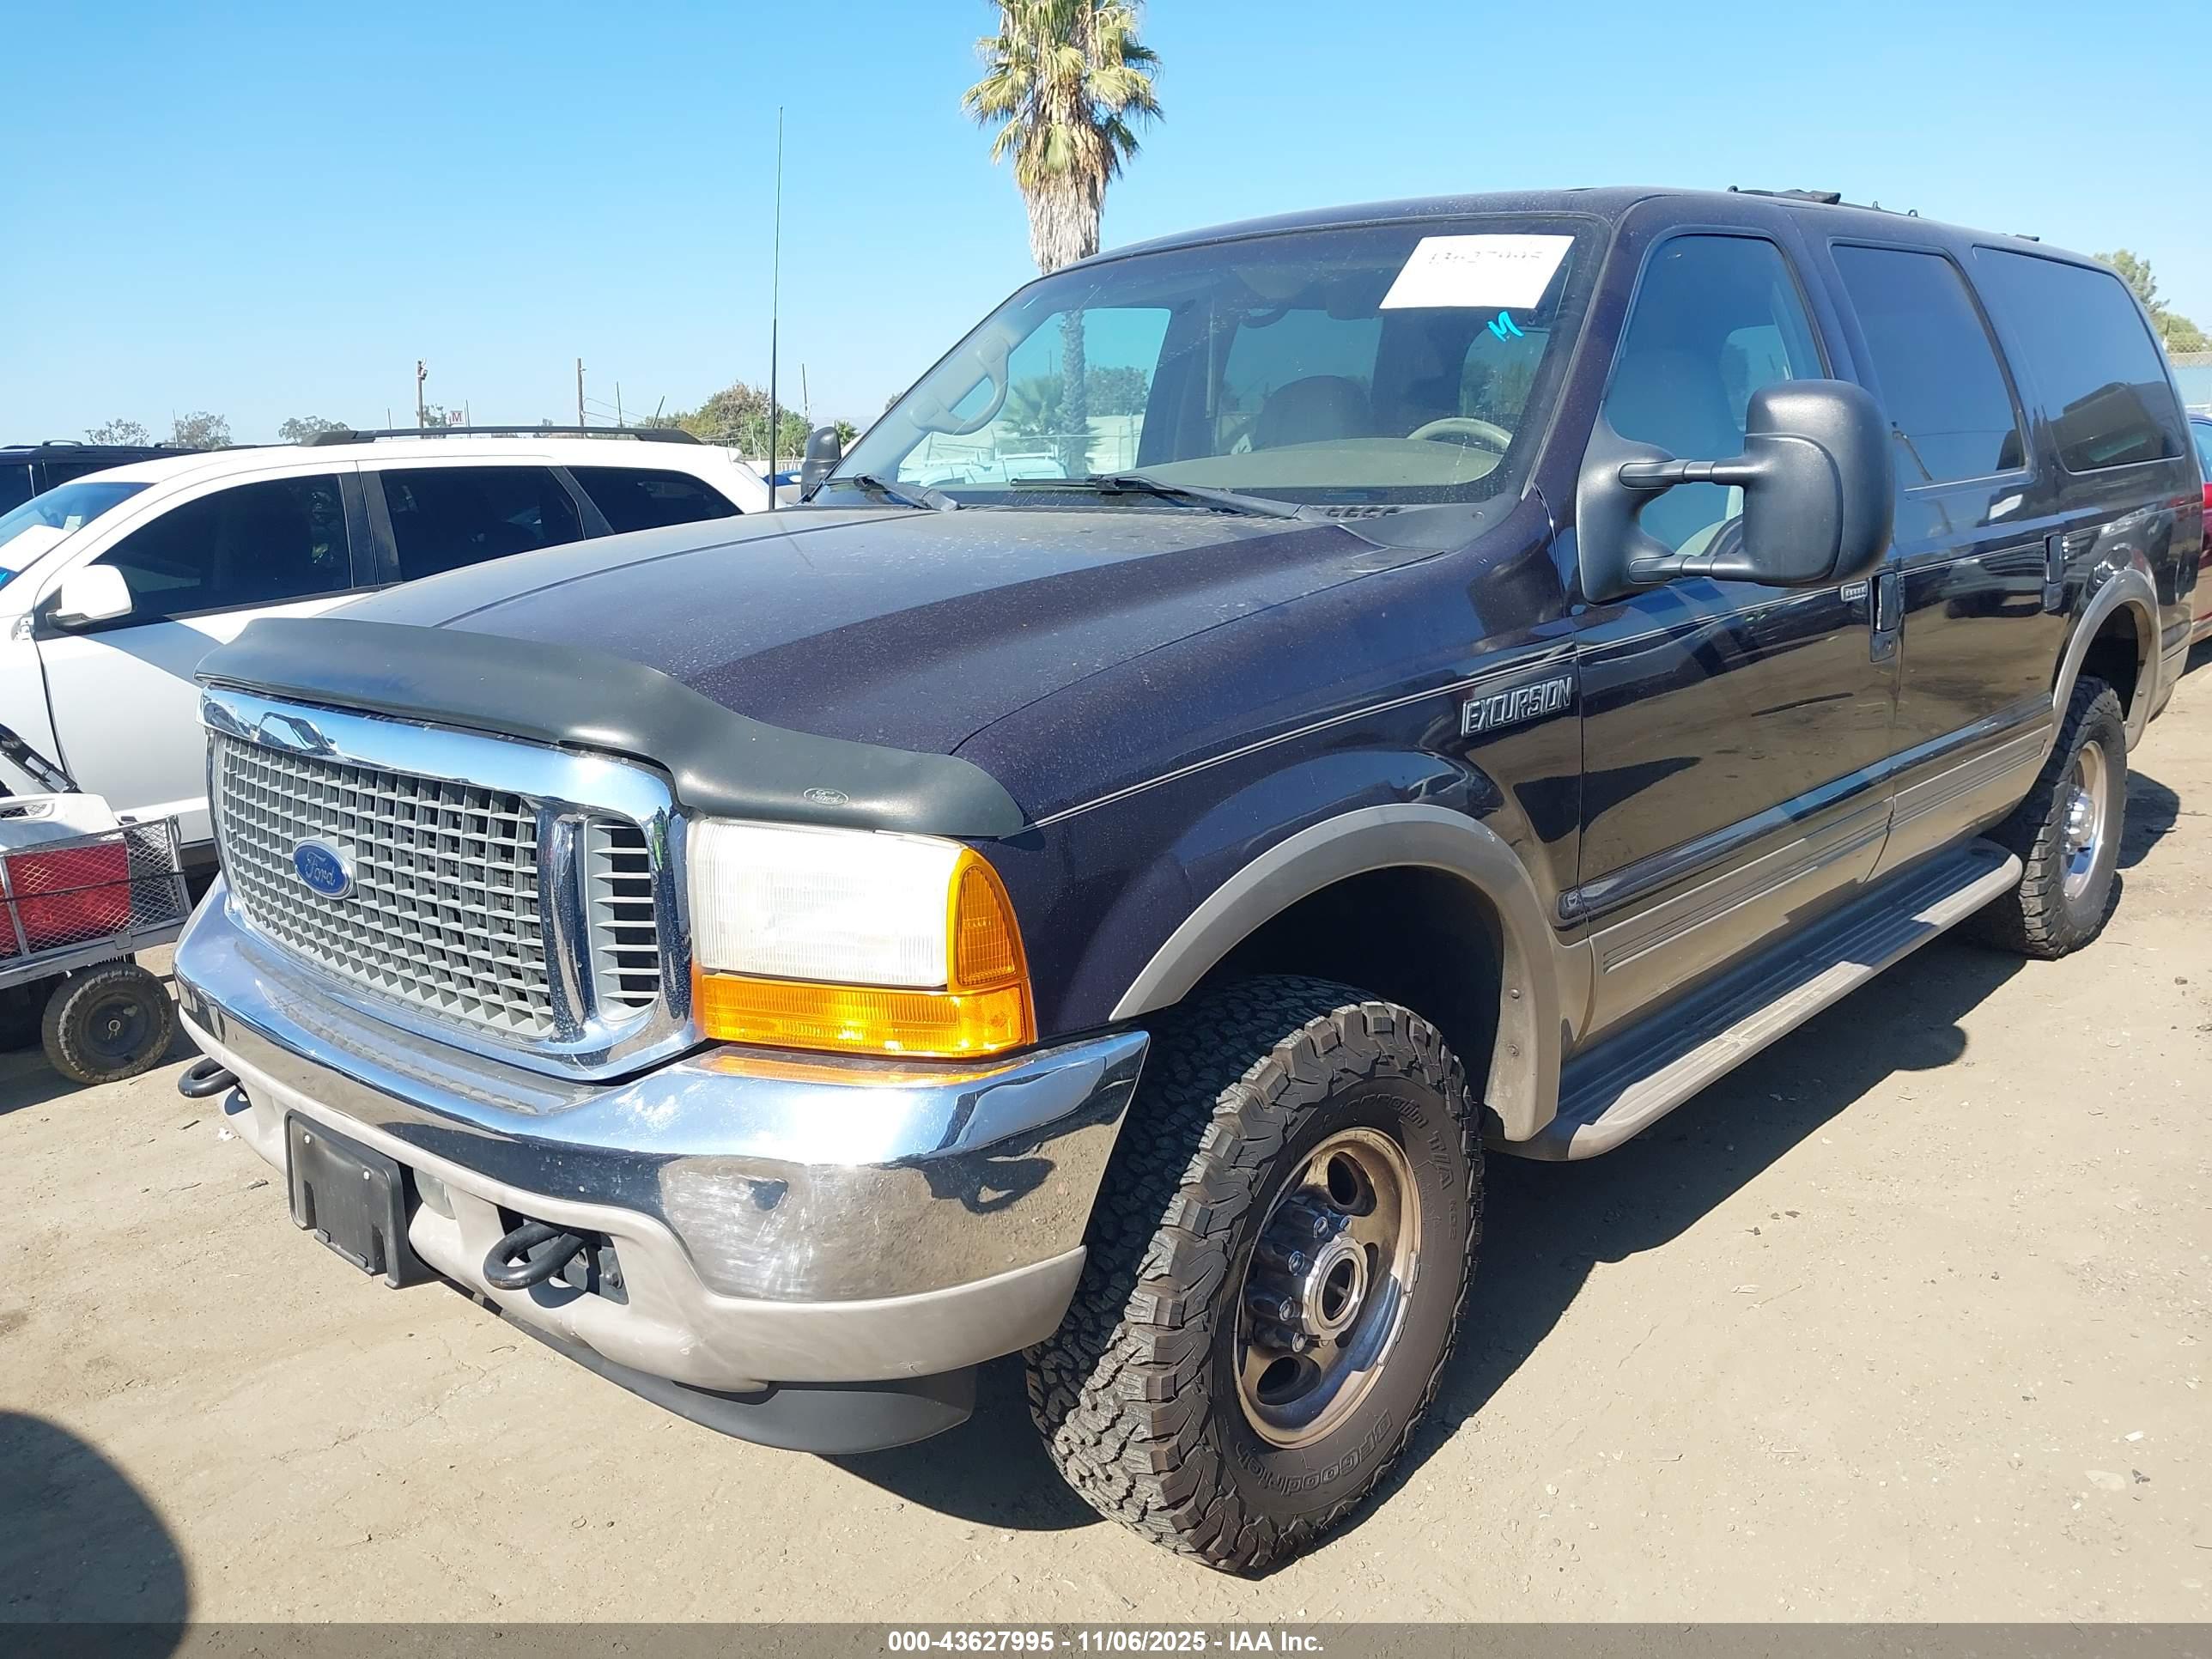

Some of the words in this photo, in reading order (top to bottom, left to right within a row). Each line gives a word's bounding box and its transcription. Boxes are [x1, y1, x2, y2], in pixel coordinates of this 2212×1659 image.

[452, 412, 462, 422] M
[1464, 676, 1573, 734] EXCURSION
[304, 851, 336, 887] Ford
[1427, 1129, 1455, 1190] T/A
[1235, 1408, 1394, 1498] BFGoodrich
